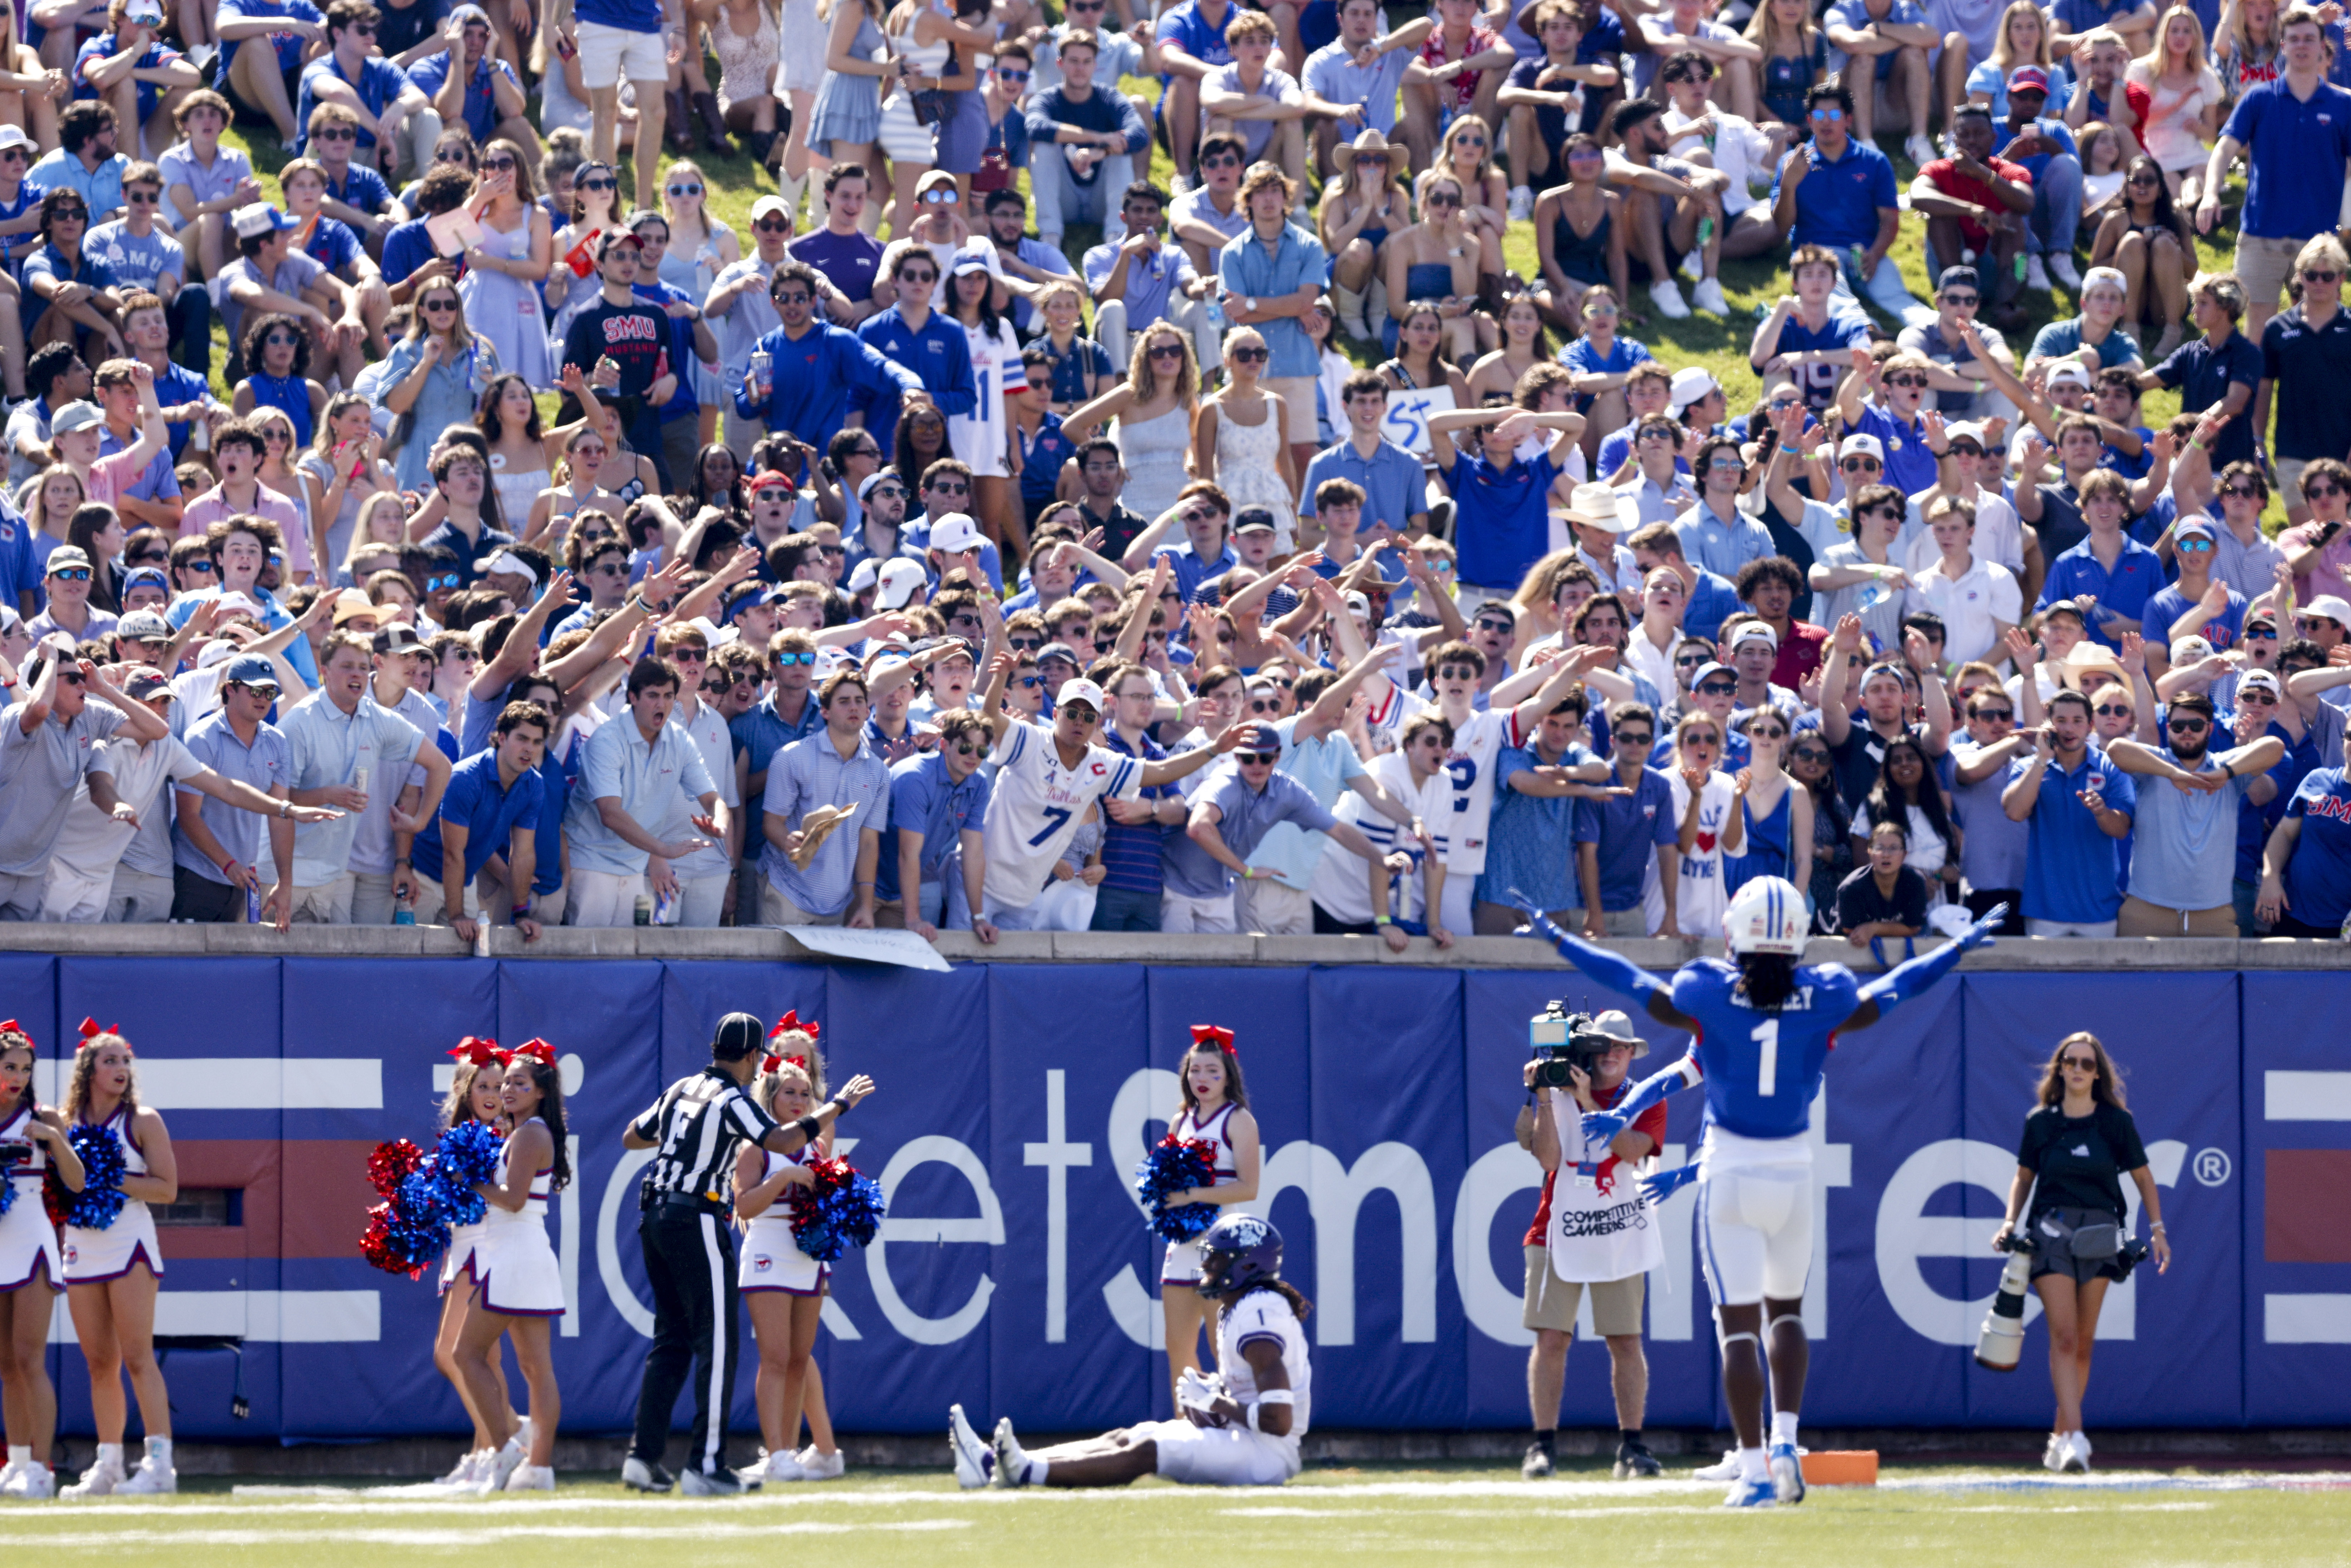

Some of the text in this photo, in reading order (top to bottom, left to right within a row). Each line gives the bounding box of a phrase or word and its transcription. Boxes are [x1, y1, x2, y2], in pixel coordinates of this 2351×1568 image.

[602, 314, 657, 343] SMU
[606, 343, 658, 355] MUSTAN
[967, 369, 989, 421] 1
[1388, 397, 1431, 447] St
[2199, 627, 2233, 648] MU
[1044, 786, 1082, 805] Dallas
[1028, 805, 1073, 847] 7
[1730, 985, 1814, 1011] CLEY
[1751, 1018, 1779, 1097] 1
[1562, 1197, 1646, 1223] COMPETITIVE
[1226, 1218, 1268, 1238] TCU
[1562, 1218, 1626, 1237] CAMERAS
[1256, 1308, 1265, 1327] 1
